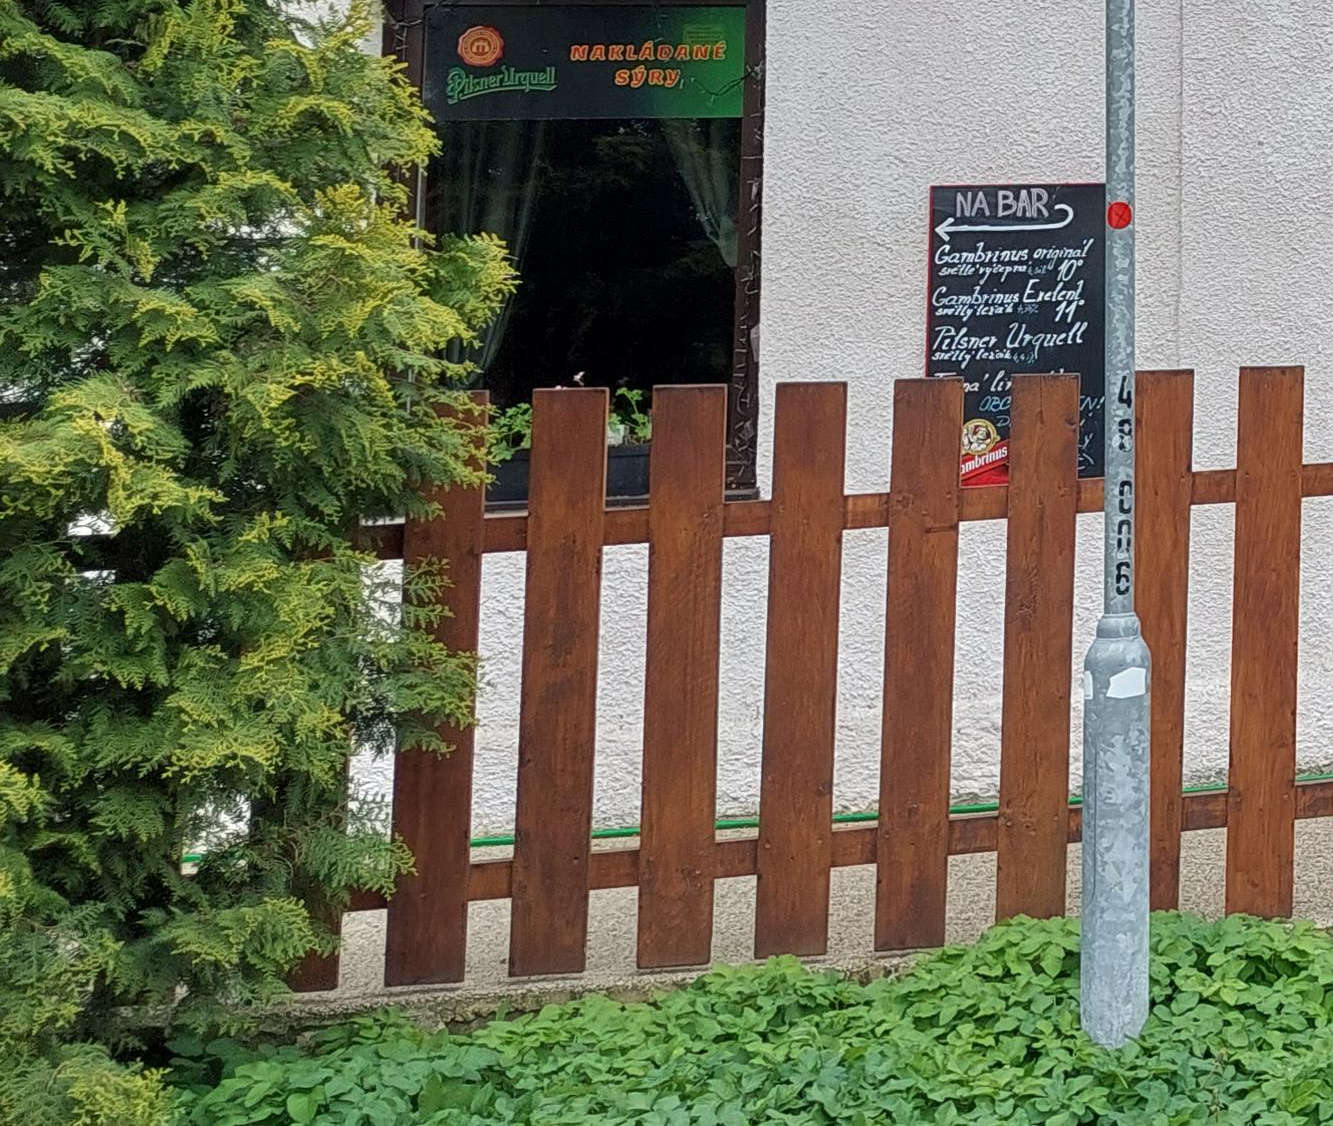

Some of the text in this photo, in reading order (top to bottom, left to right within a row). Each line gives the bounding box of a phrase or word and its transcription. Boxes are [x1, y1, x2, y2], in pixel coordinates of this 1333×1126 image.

[570, 40, 727, 62] NAKLÁDANÉ
[446, 64, 557, 105] Pilsner Urquell
[614, 64, 682, 89] SÝRY
[956, 188, 1049, 218] NA BAR
[934, 241, 1028, 265] Gambrinus
[931, 285, 1020, 307] Gambrinus
[932, 321, 1088, 360] Pilsner Urquell
[961, 446, 1008, 475] ambrinus
